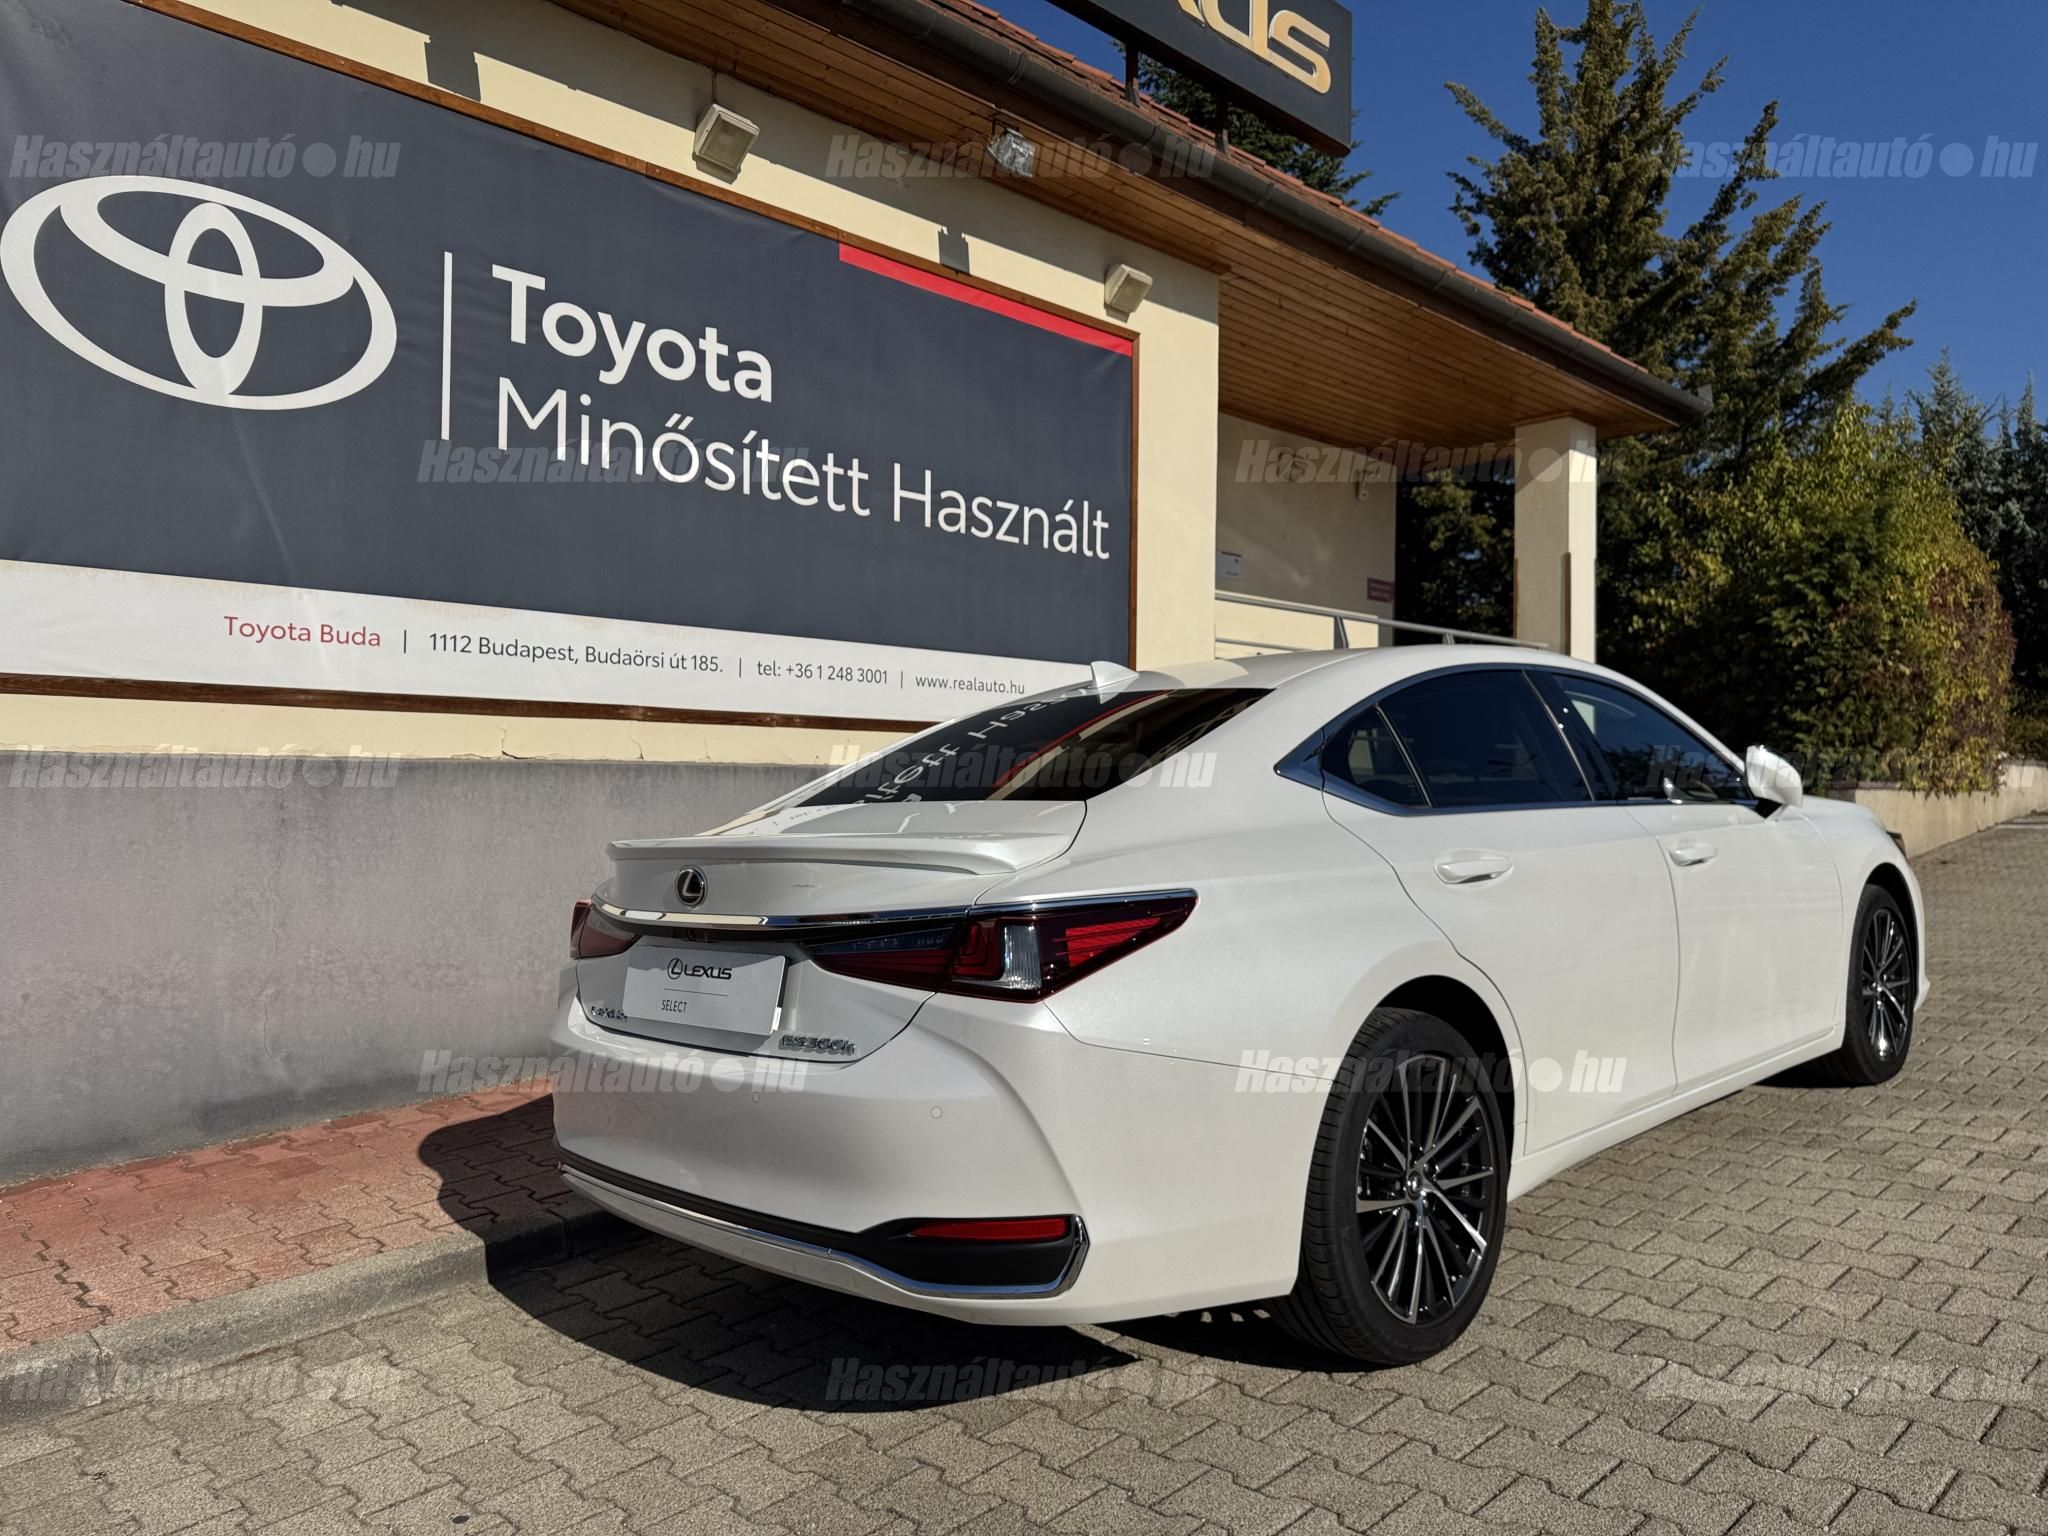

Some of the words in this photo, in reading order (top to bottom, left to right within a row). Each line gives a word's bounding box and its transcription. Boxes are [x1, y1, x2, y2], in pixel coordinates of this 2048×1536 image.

[492, 264, 772, 402] Toyota
[498, 376, 871, 517] Minősített
[893, 462, 1110, 560] Használt
[224, 616, 311, 643] Toyota
[320, 624, 381, 647] Buda
[429, 633, 472, 654] 1112
[478, 636, 579, 665] Budapest,
[585, 645, 665, 669] Budaörsi
[670, 652, 688, 670] út
[691, 654, 724, 673] 185.
[757, 660, 782, 678] tel:
[786, 662, 813, 680] +36
[827, 665, 854, 683] 248
[857, 667, 888, 685] 3001
[915, 674, 1026, 695] www.realauto.hu
[684, 964, 733, 980] LEXUS
[661, 1000, 687, 1013] SELECT
